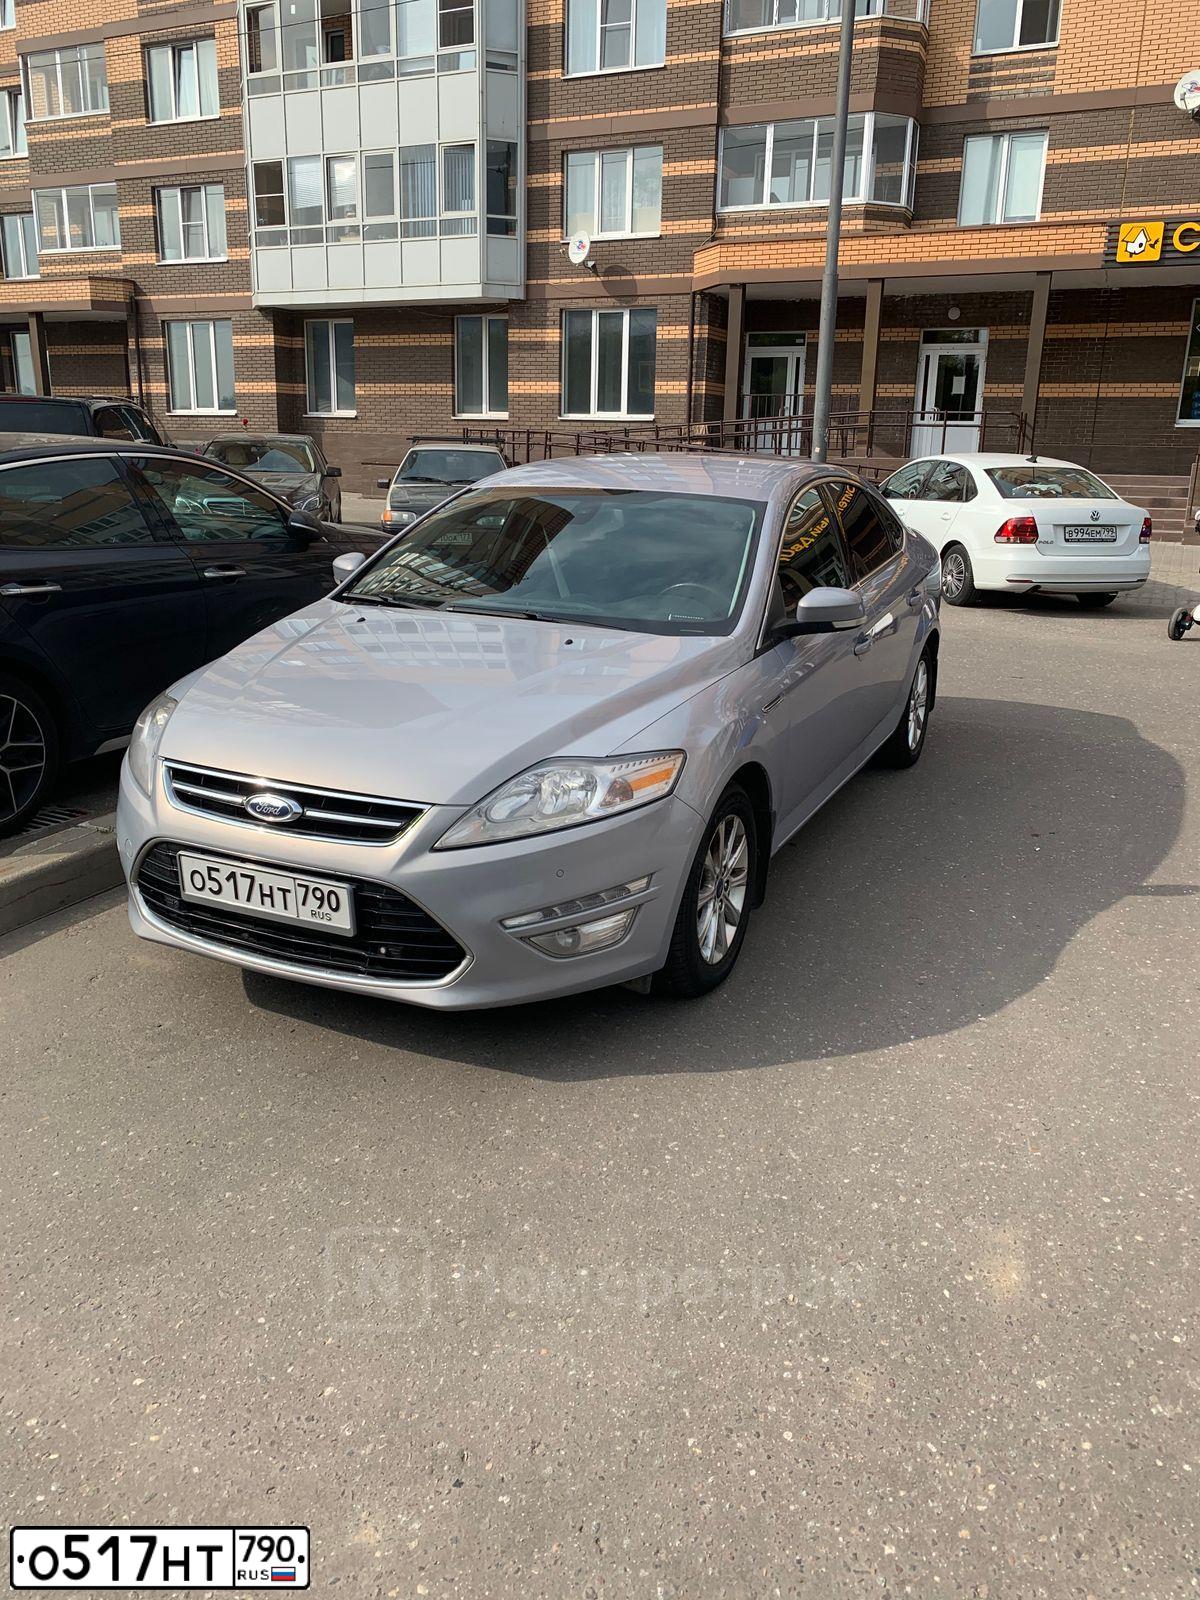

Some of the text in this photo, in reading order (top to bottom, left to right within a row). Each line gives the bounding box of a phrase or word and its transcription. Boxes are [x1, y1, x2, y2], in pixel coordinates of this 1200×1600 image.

[255, 801, 281, 815] Ford
[190, 866, 341, 913] О517НТ 790
[310, 909, 332, 921] RUS
